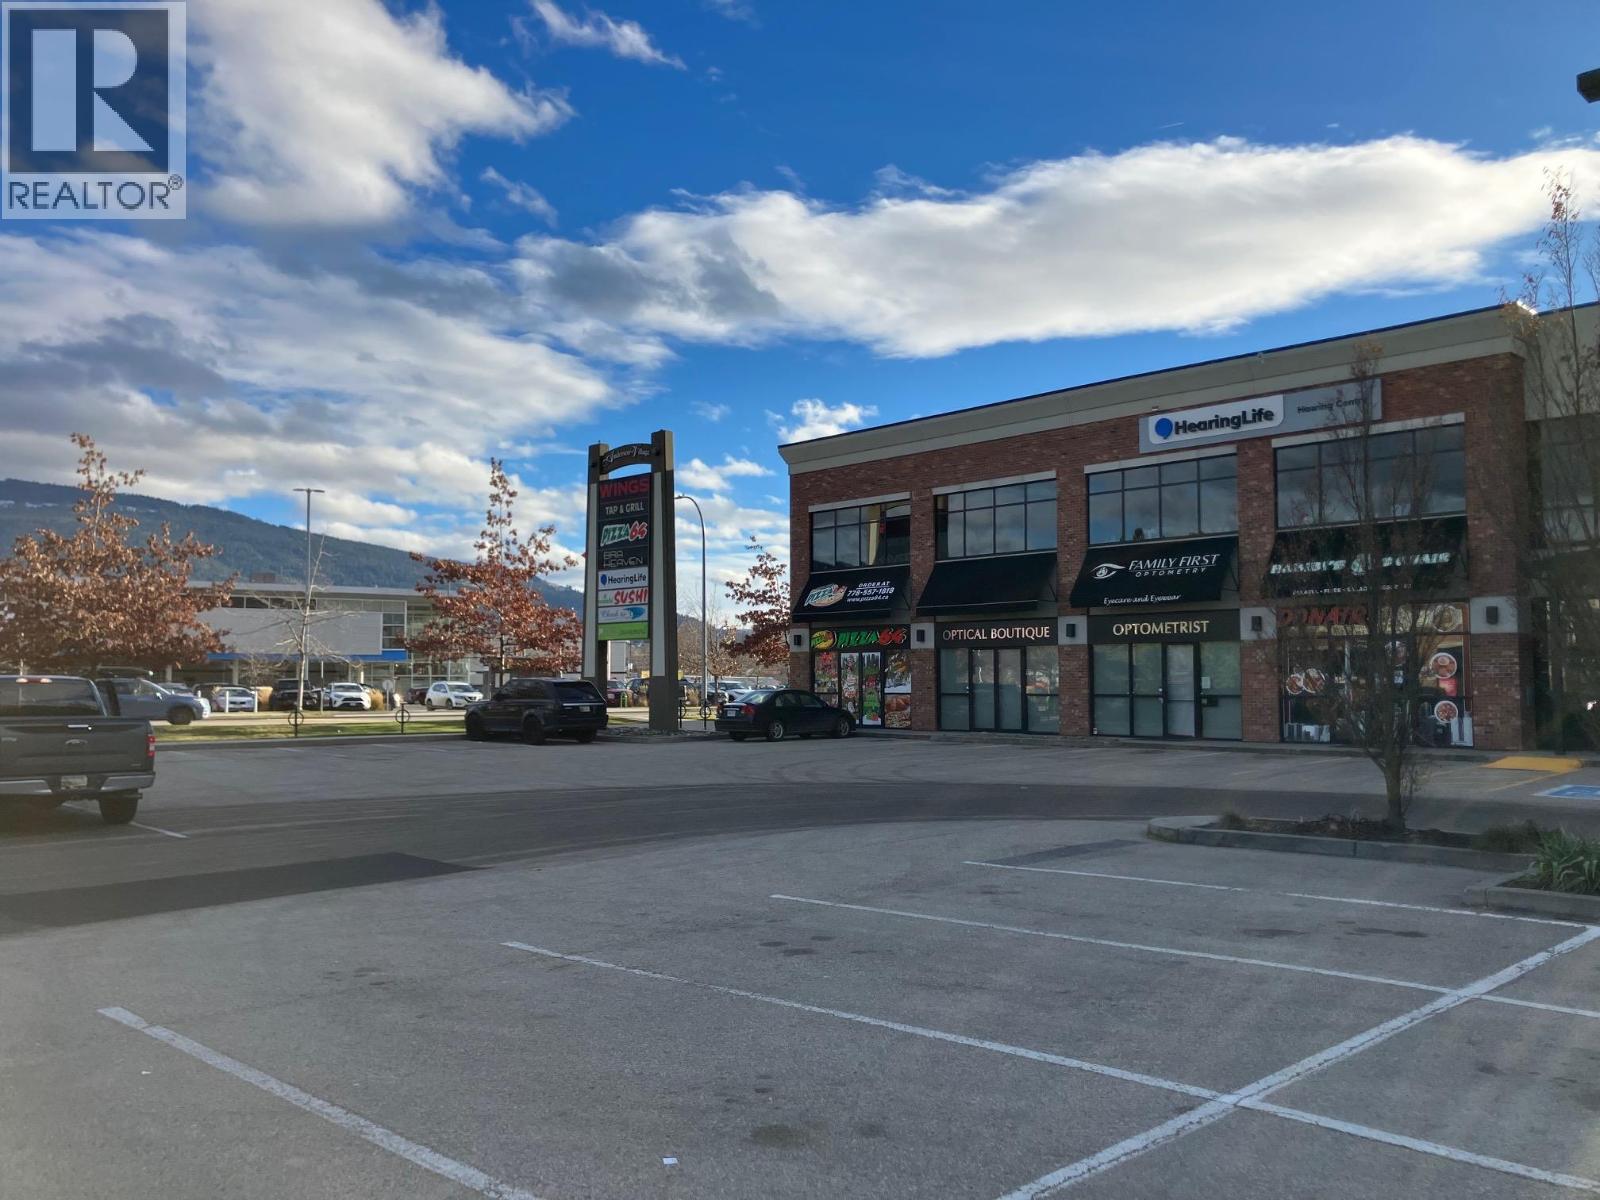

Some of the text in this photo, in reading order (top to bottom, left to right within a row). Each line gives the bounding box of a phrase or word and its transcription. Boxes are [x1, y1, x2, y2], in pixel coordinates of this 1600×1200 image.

[1174, 407, 1275, 436] HearingLife
[599, 478, 649, 497] WINGS
[605, 504, 618, 515] TAP
[625, 501, 645, 513] GRILL
[603, 556, 643, 569] HEAVEN
[1128, 553, 1221, 571] FAMILY FIRST
[608, 573, 647, 585] HearingLife
[1135, 567, 1207, 578] OPTOMETRY
[614, 588, 648, 605] SUSHI
[942, 626, 1050, 641] OPTICAL BOUTIQUE
[1112, 620, 1210, 636] OPTOMETRIST
